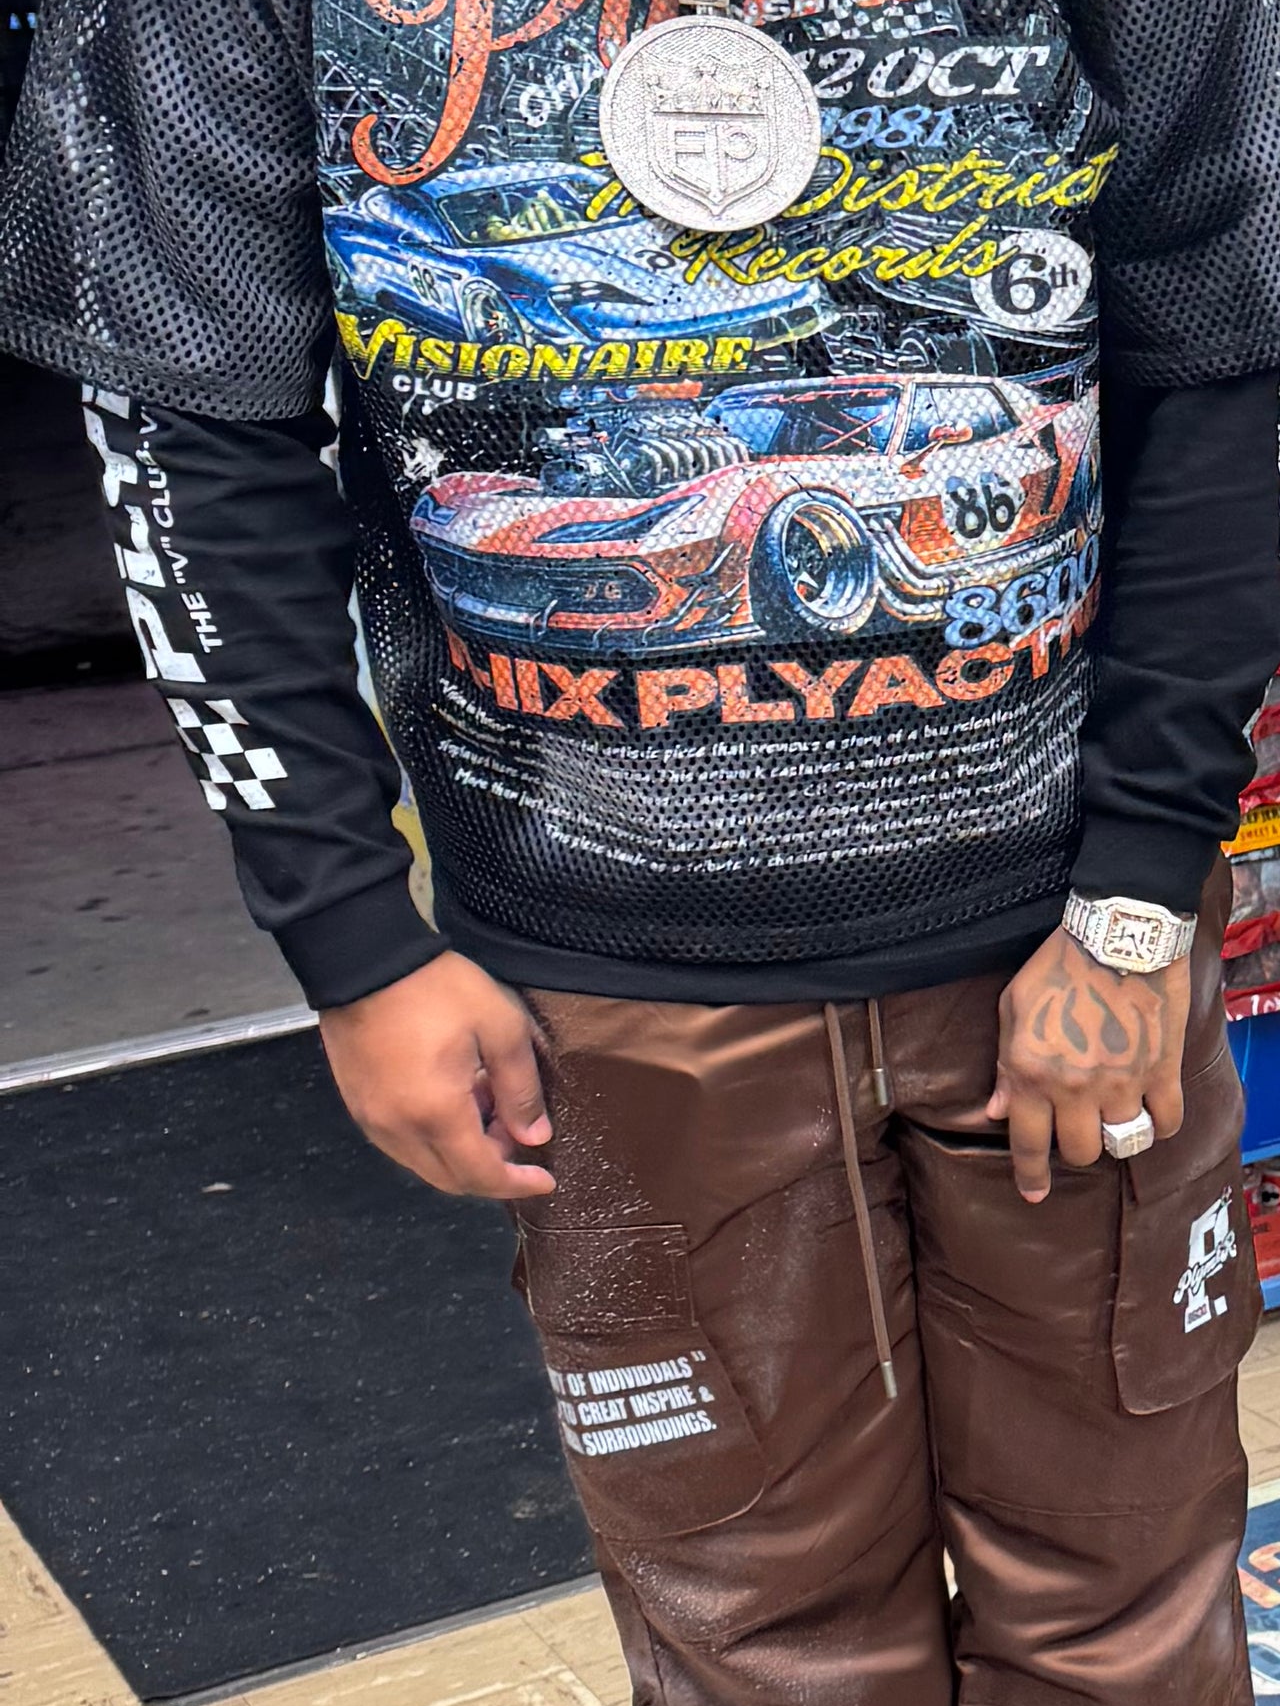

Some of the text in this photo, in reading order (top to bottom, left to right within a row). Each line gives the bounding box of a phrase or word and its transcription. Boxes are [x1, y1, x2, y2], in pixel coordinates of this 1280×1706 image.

[672, 224, 1017, 286] Records
[1000, 245, 1083, 319] 6th
[335, 311, 752, 383] VISIONAIRE
[392, 376, 478, 402] CLUB
[950, 474, 1020, 539] 86
[181, 592, 224, 654] THE
[568, 1358, 693, 1396] OF INDIVIDUALS
[578, 1385, 715, 1425] CREAT INSPIRE &
[581, 1410, 717, 1456] SURROUNDINGS.
